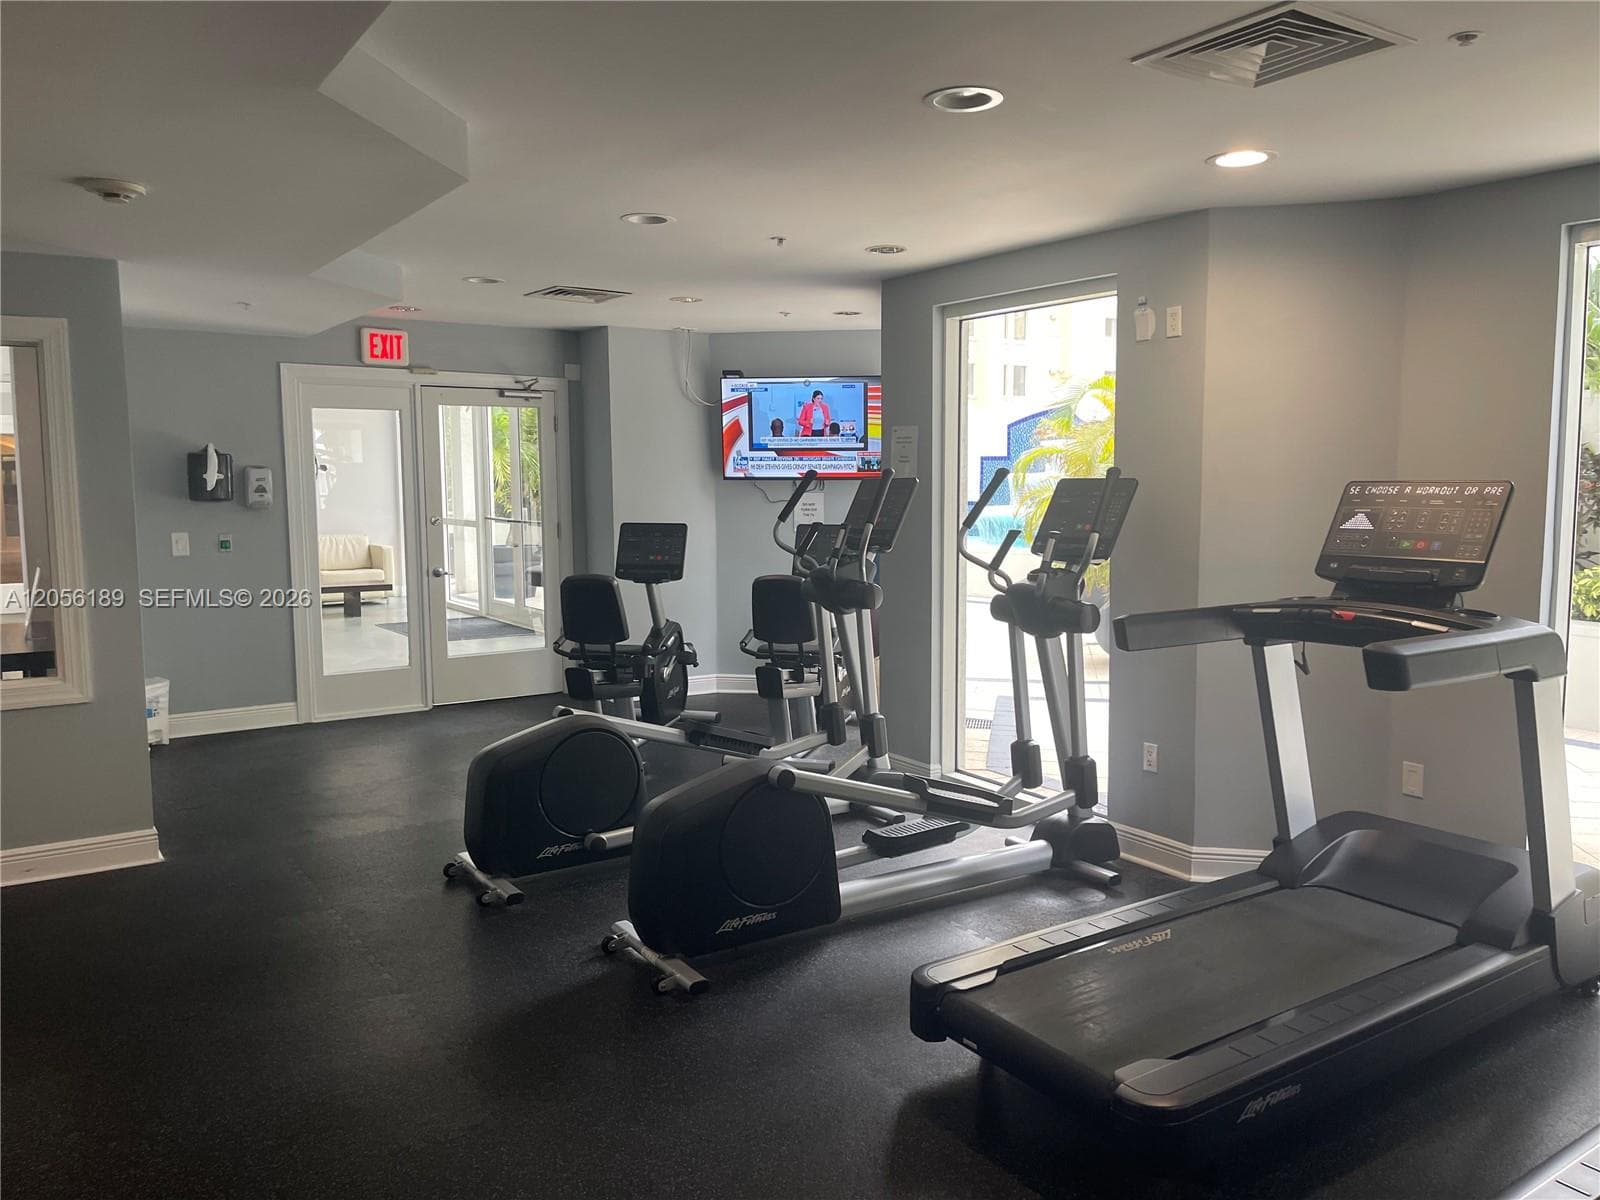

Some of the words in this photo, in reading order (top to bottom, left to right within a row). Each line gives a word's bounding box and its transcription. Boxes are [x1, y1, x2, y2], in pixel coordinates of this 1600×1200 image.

[368, 332, 403, 360] EXIT
[1349, 485, 1361, 495] SE
[1365, 485, 1400, 495] CHOOSE
[1404, 486, 1412, 495] A
[1416, 486, 1460, 495] WORKOUT
[1464, 486, 1478, 496] OR
[1483, 486, 1504, 496] PRE
